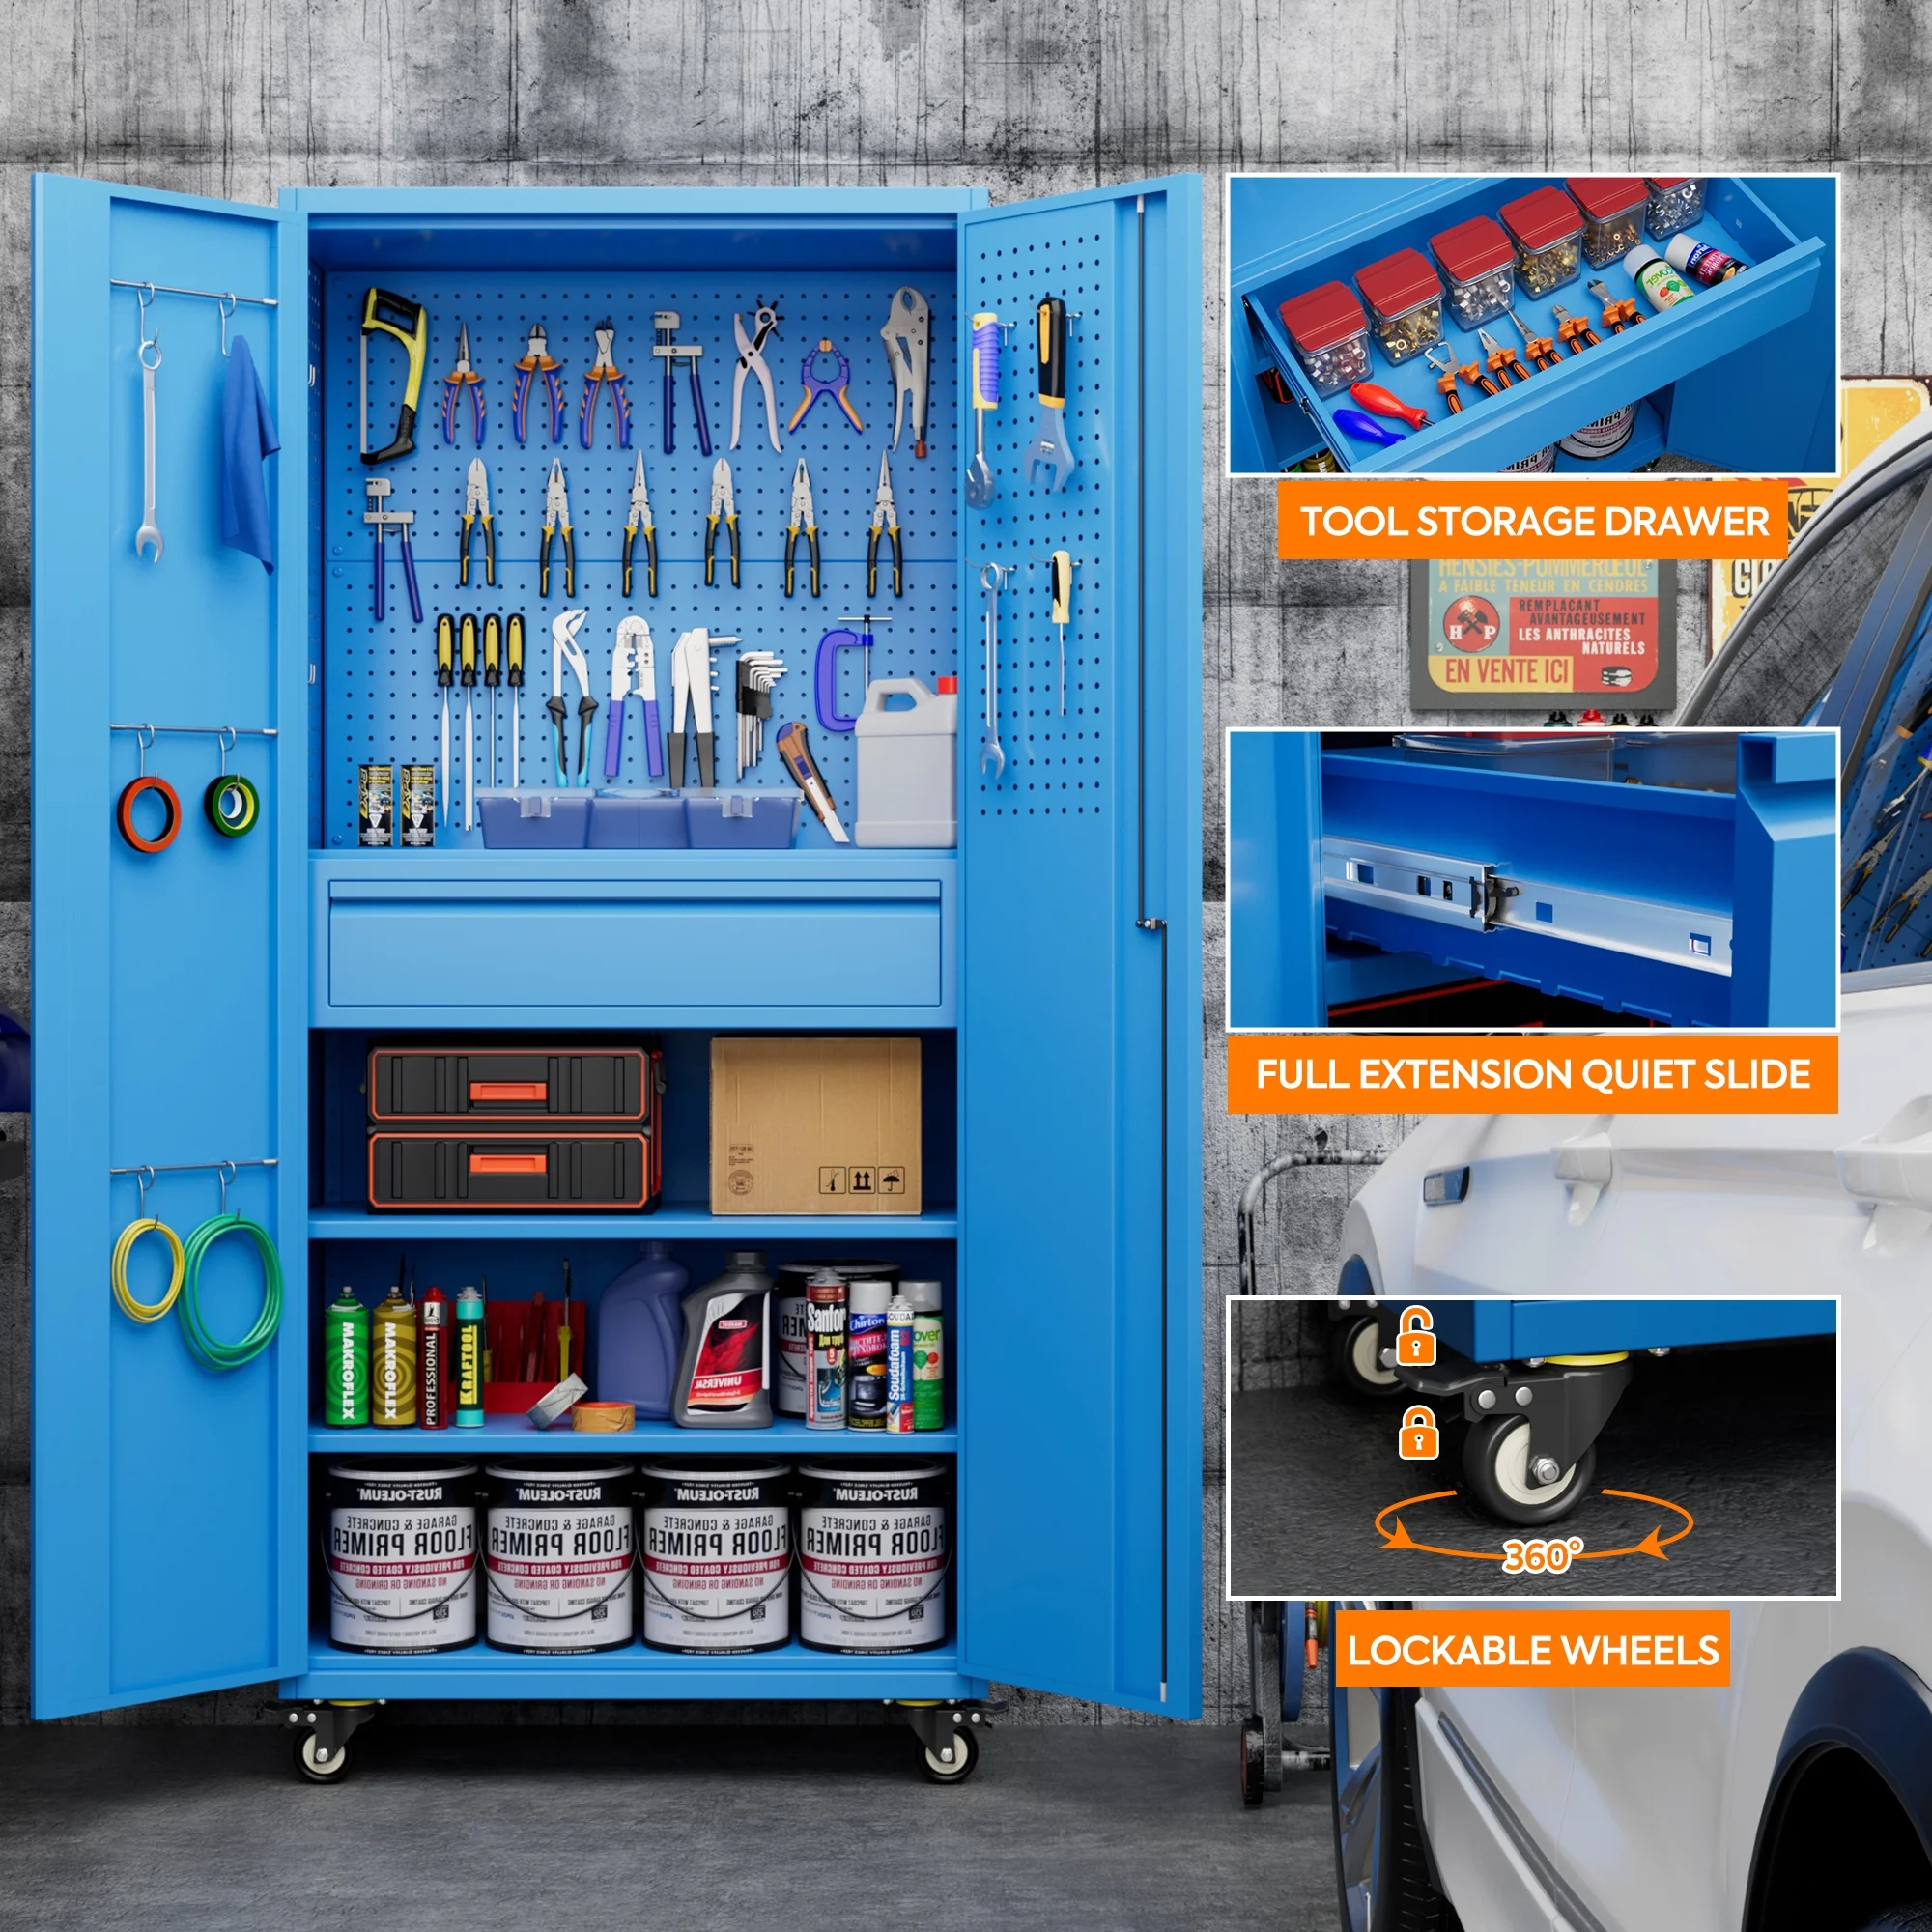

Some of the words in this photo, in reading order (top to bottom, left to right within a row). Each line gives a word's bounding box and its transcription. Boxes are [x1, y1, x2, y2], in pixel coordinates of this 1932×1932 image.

[1438, 581, 1448, 593] A
[1454, 581, 1497, 593] FAIBLE
[1505, 581, 1555, 593] TENEUR
[1563, 581, 1581, 593] EN
[1588, 580, 1649, 593] CENDRES
[1530, 612, 1646, 626] AVANTAGEUSEMENT
[1449, 625, 1463, 639] H
[1484, 625, 1496, 639] P
[1519, 628, 1541, 641] LES
[1546, 628, 1631, 641] ANTHRACITES
[1582, 641, 1646, 655] NATURELS
[1445, 658, 1471, 684] EN
[1477, 658, 1538, 684] VENTE
[1545, 658, 1569, 684] ICI
[850, 1318, 885, 1331] Chirton
[342, 1321, 355, 1420] MAKROFLEX
[384, 1321, 398, 1420] MAKROFLEX
[459, 1324, 473, 1405] KRAFTOOL
[889, 1329, 900, 1401] Soudafoam
[425, 1332, 436, 1426] PROFESSIONAL
